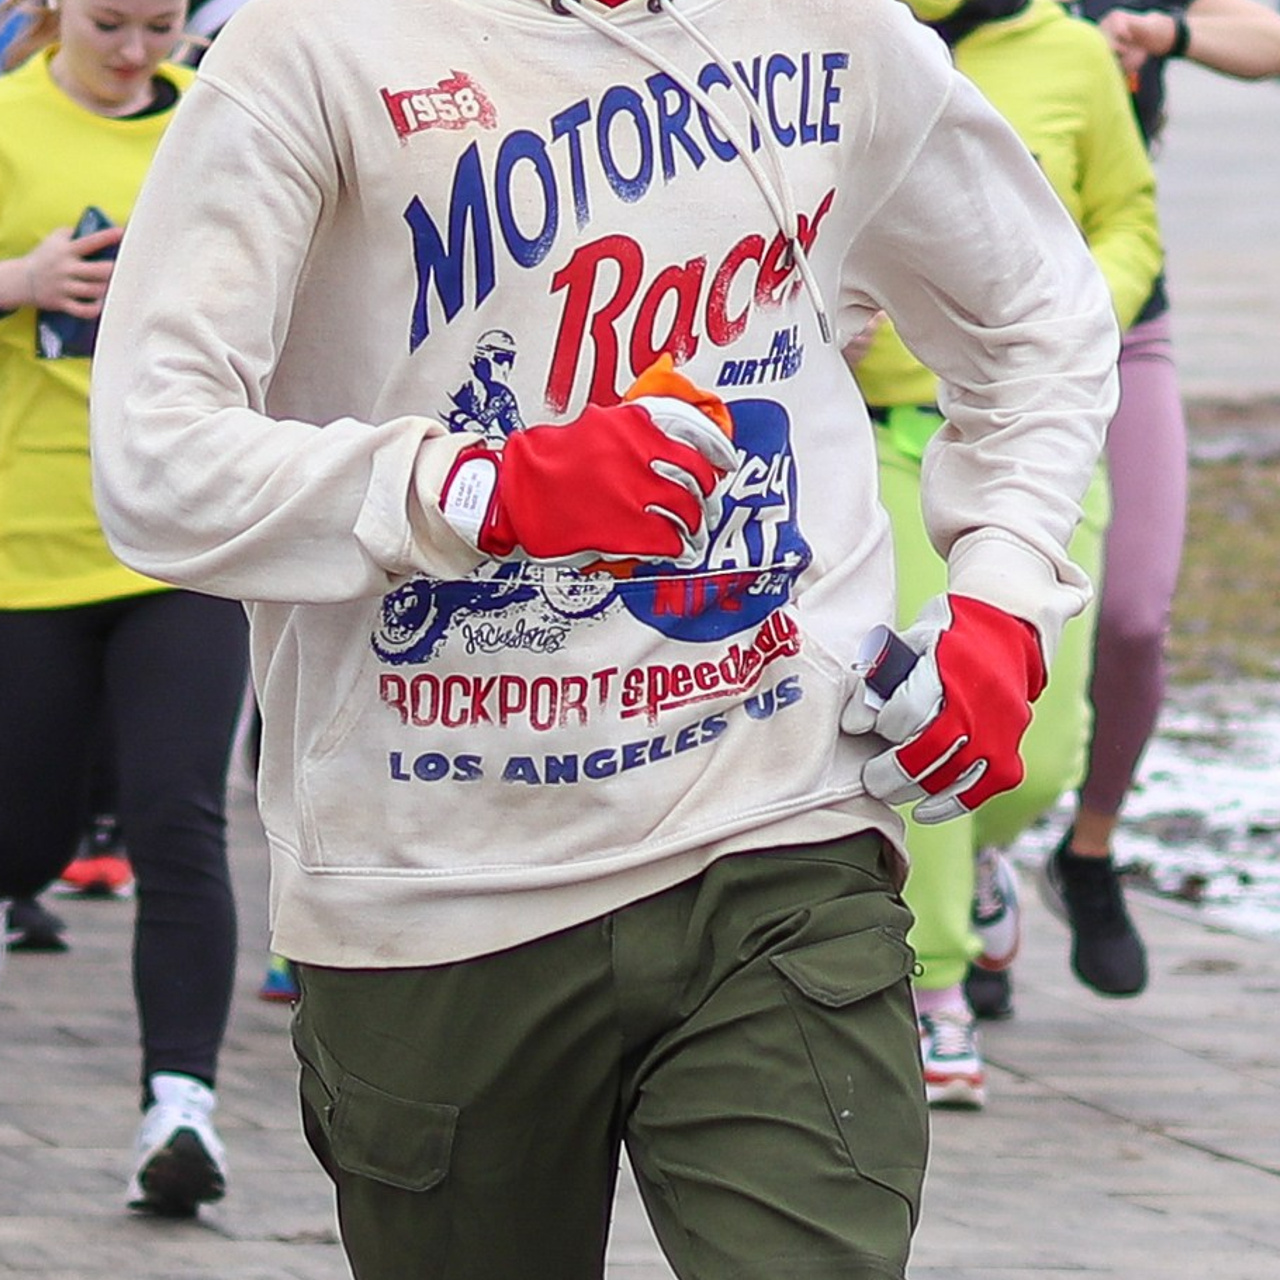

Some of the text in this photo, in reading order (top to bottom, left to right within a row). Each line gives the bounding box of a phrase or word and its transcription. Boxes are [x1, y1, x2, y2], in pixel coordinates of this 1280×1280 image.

[402, 87, 481, 132] 1958
[403, 51, 851, 355] MOTORCYCLE
[379, 667, 619, 732] ROCKPORT
[389, 674, 804, 785] LOS ANGELES US
